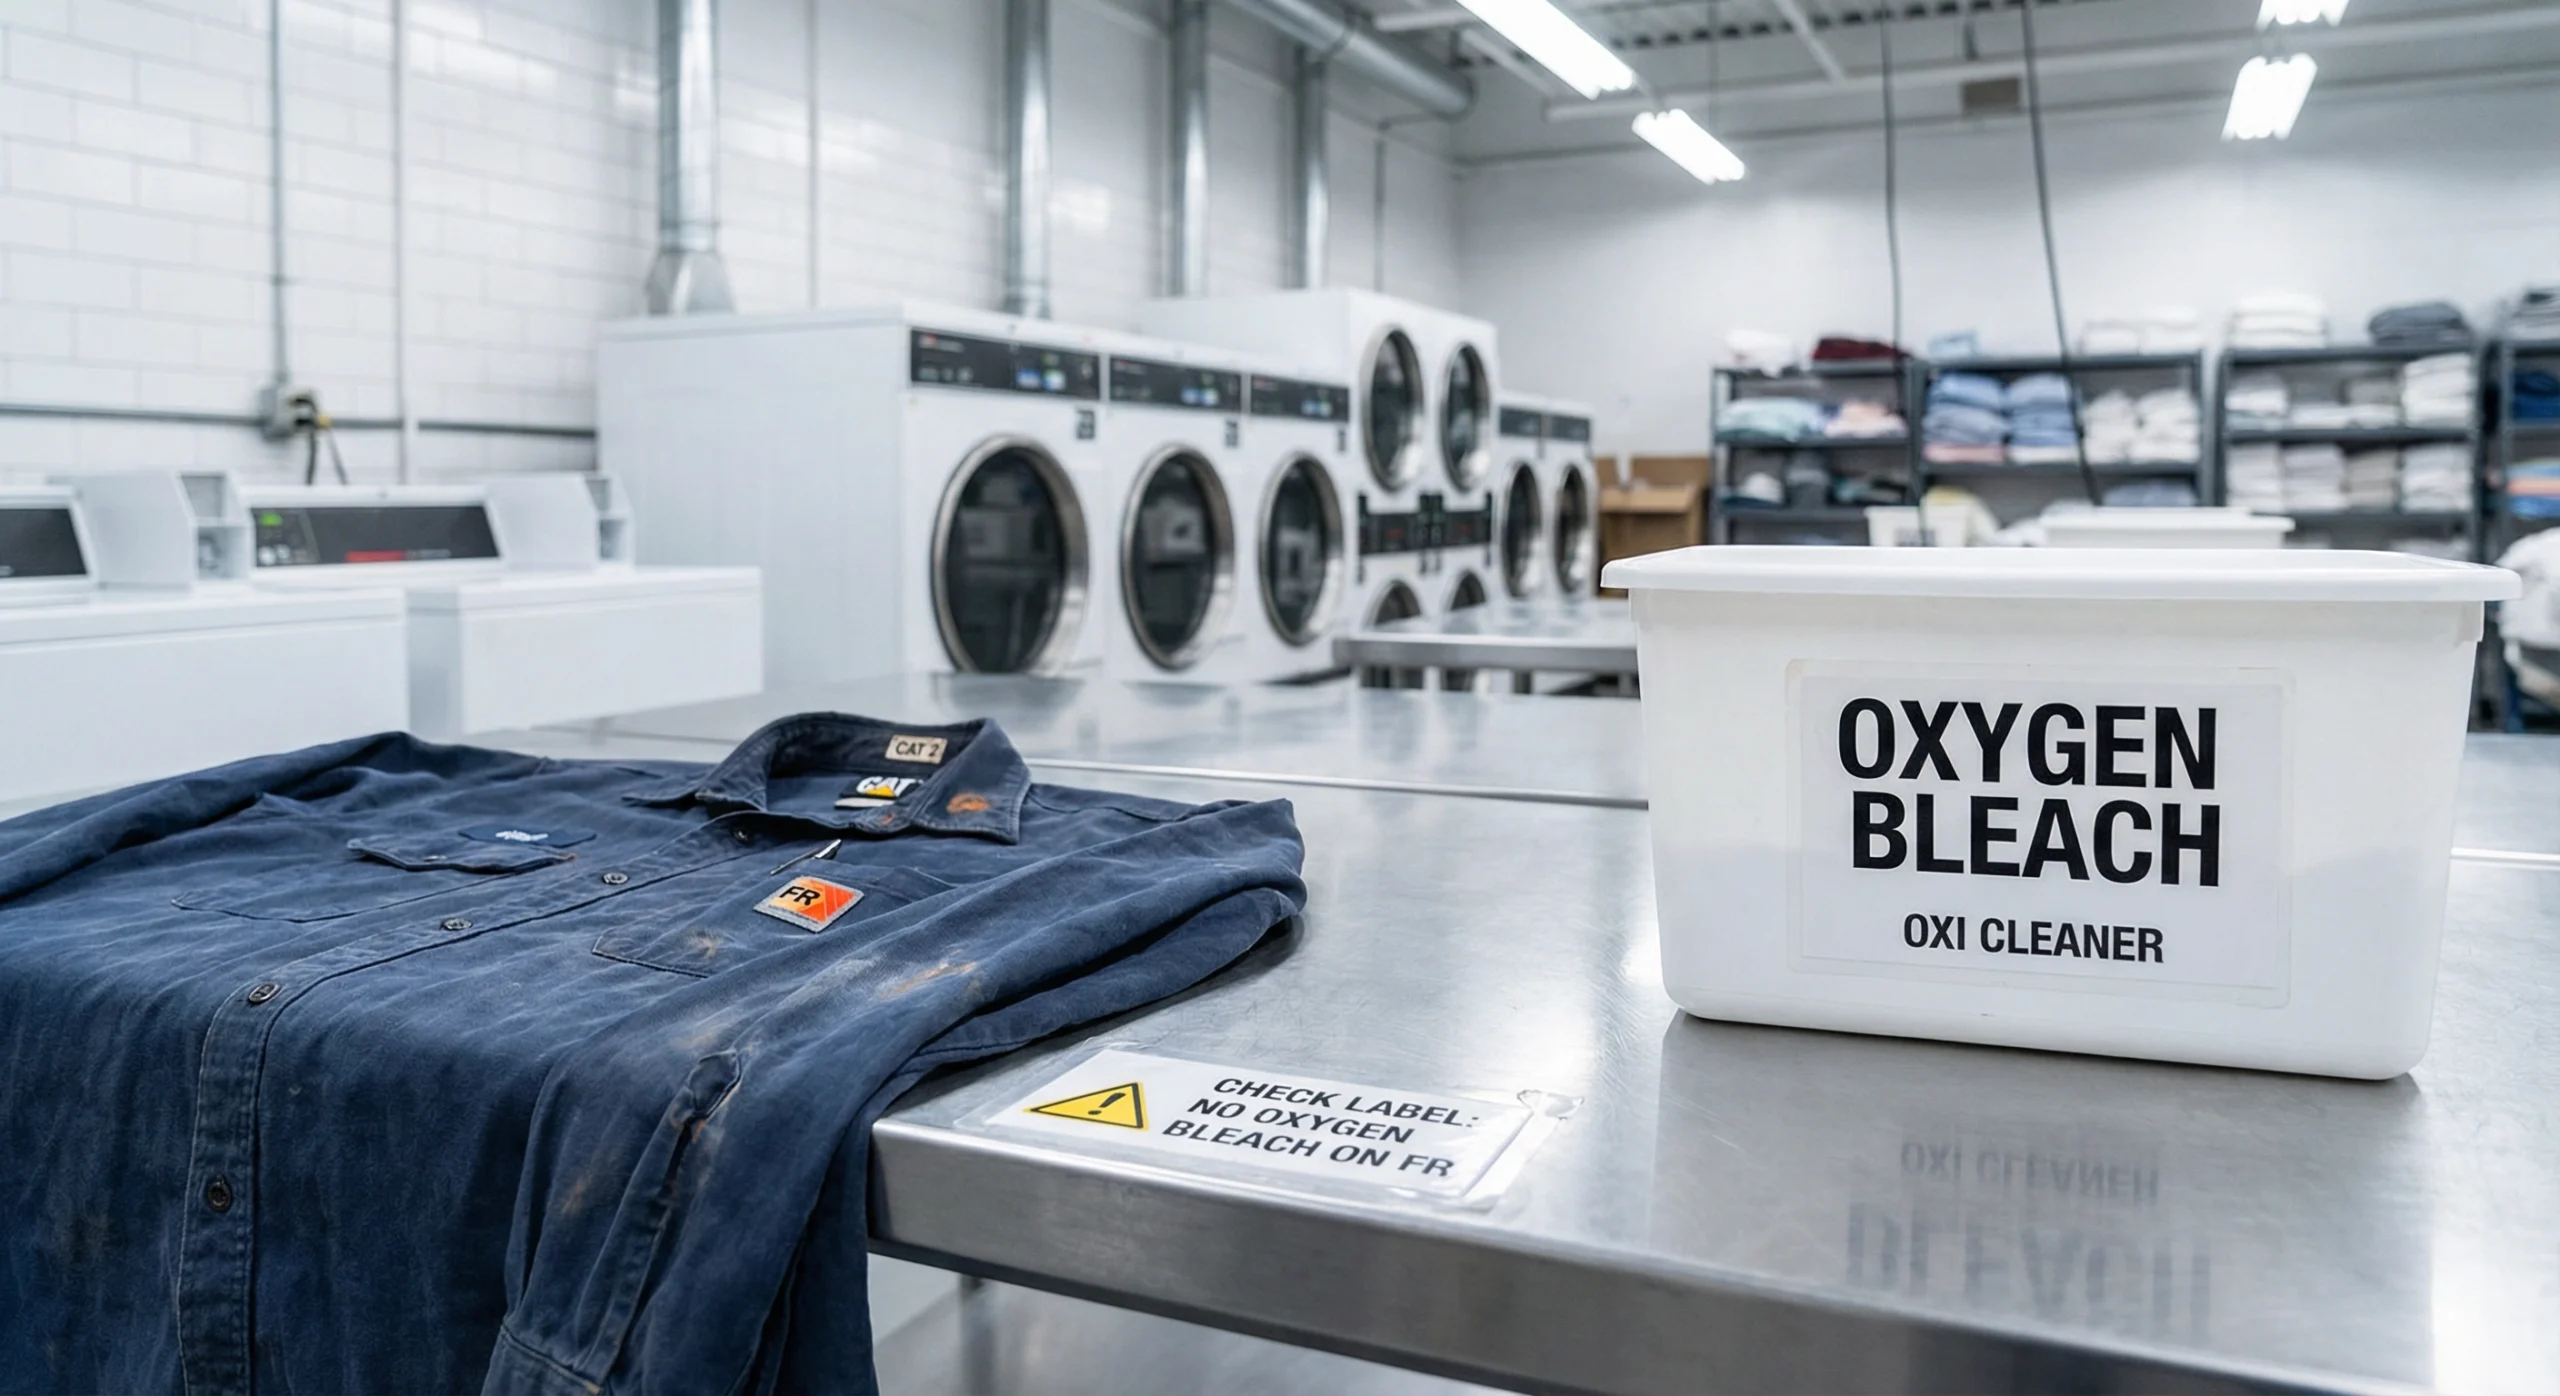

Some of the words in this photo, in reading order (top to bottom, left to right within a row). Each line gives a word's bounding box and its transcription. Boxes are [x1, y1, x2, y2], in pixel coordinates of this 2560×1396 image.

[895, 741, 926, 756] CAT
[928, 743, 940, 757] 2
[1838, 697, 2217, 791] OXYGEN
[856, 776, 917, 797] CAT
[1851, 790, 2221, 888] BLEACH
[778, 885, 821, 907] FR
[1903, 913, 1966, 951] OXI
[1979, 917, 2164, 964] CLEANER
[1187, 1098, 1247, 1119] NO
[1253, 1107, 1415, 1144] OXYGEN
[1213, 1077, 1342, 1109] CHECK
[1345, 1095, 1479, 1128] LABEL:
[1161, 1119, 1323, 1157] BLEACH
[1328, 1144, 1391, 1167] ON
[1397, 1153, 1455, 1178] FR
